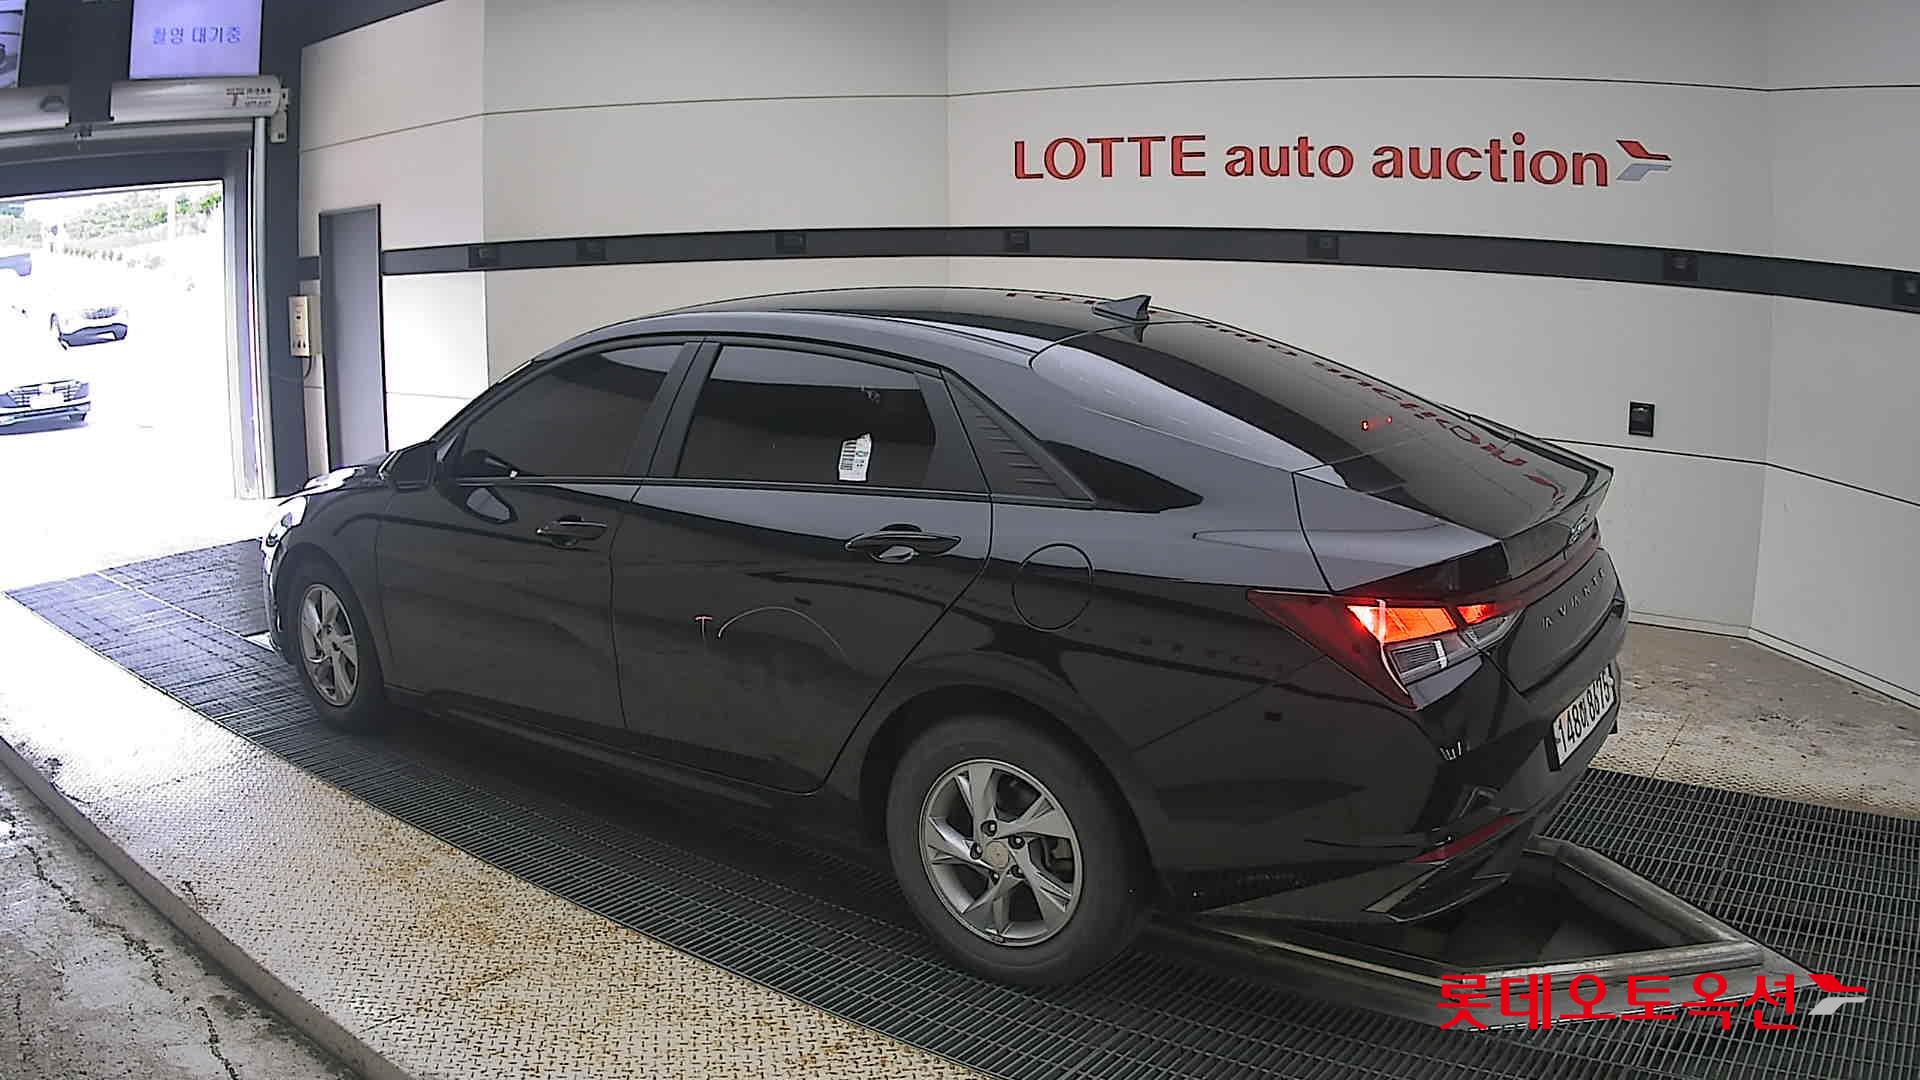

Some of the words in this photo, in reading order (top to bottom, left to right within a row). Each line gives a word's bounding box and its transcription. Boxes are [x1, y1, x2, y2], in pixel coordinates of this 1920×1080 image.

[192, 26, 241, 45] 대기중
[1014, 135, 1206, 180] LOTTE
[1225, 134, 1354, 177] auto
[1373, 131, 1607, 187] auction
